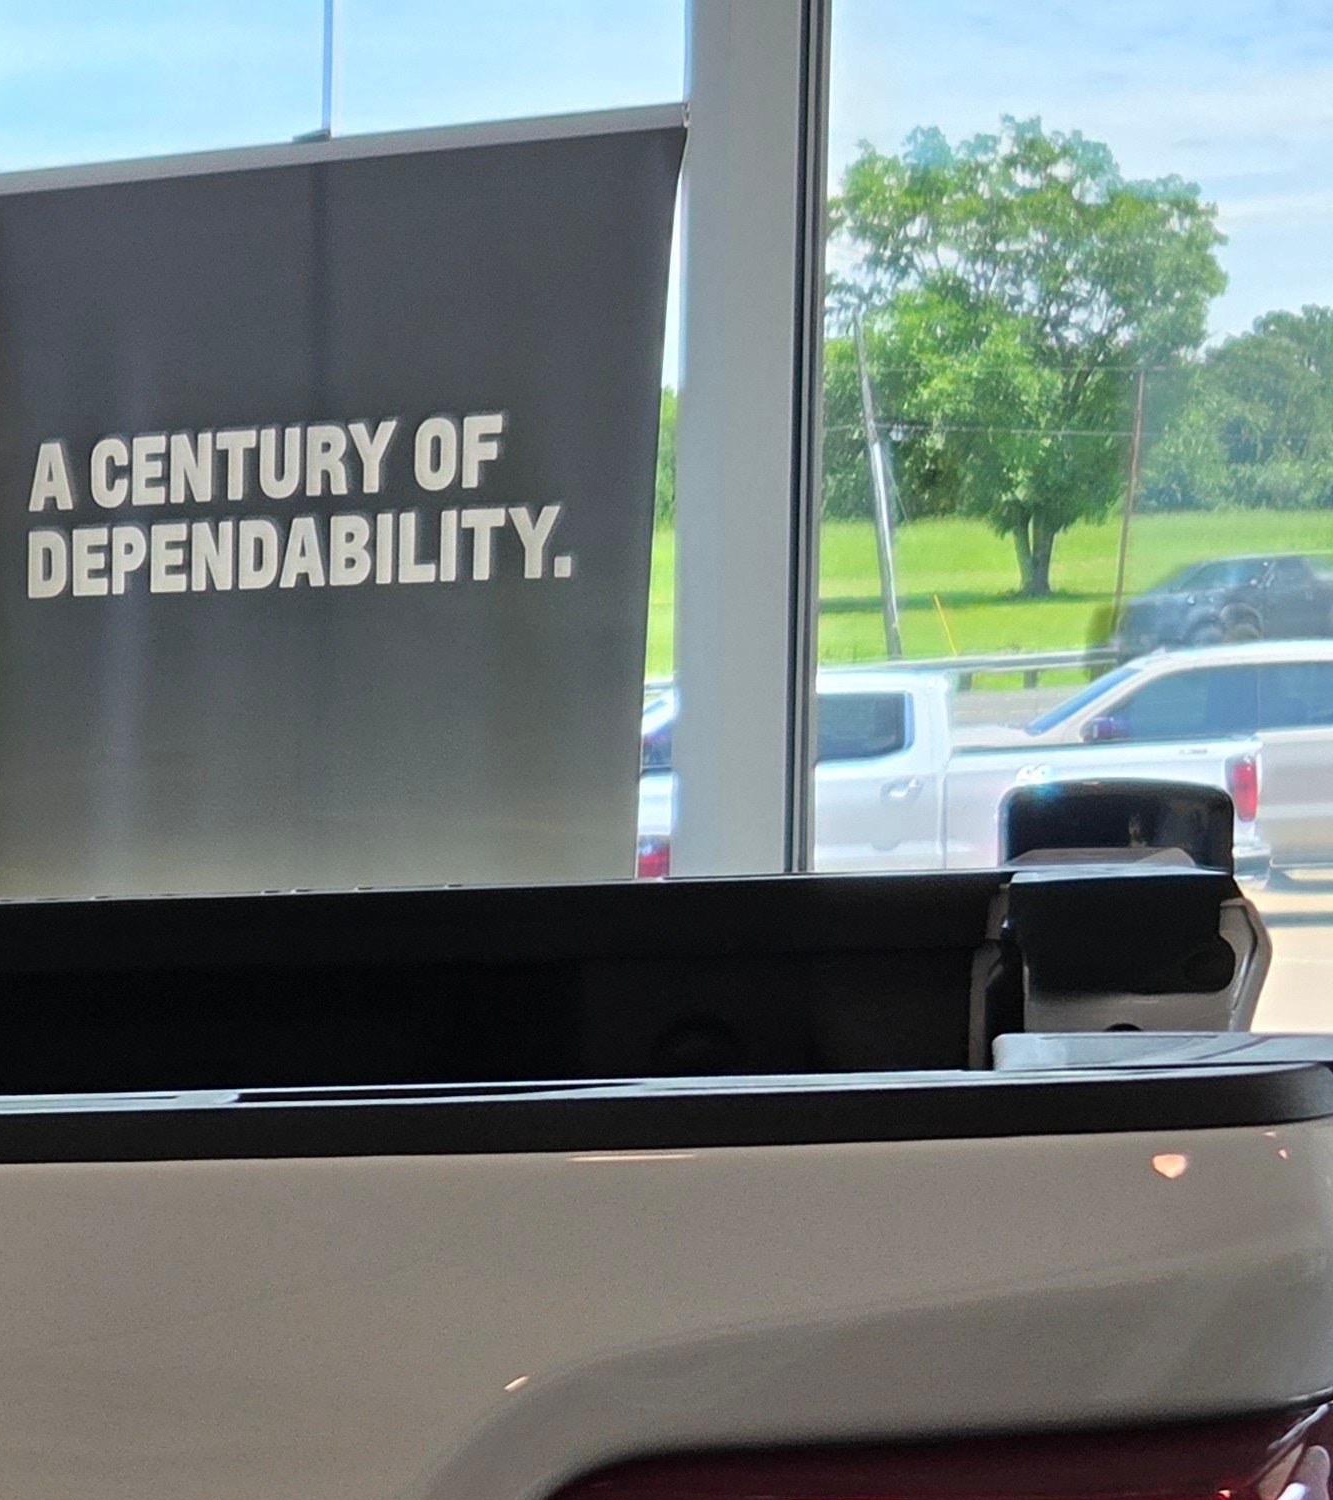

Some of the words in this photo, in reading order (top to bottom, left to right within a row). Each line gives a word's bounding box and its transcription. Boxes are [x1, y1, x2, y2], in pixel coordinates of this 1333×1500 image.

[29, 442, 74, 512] A
[90, 420, 397, 509] CENTURY
[413, 413, 504, 491] OF
[27, 505, 572, 599] DEPENDABILITY.
